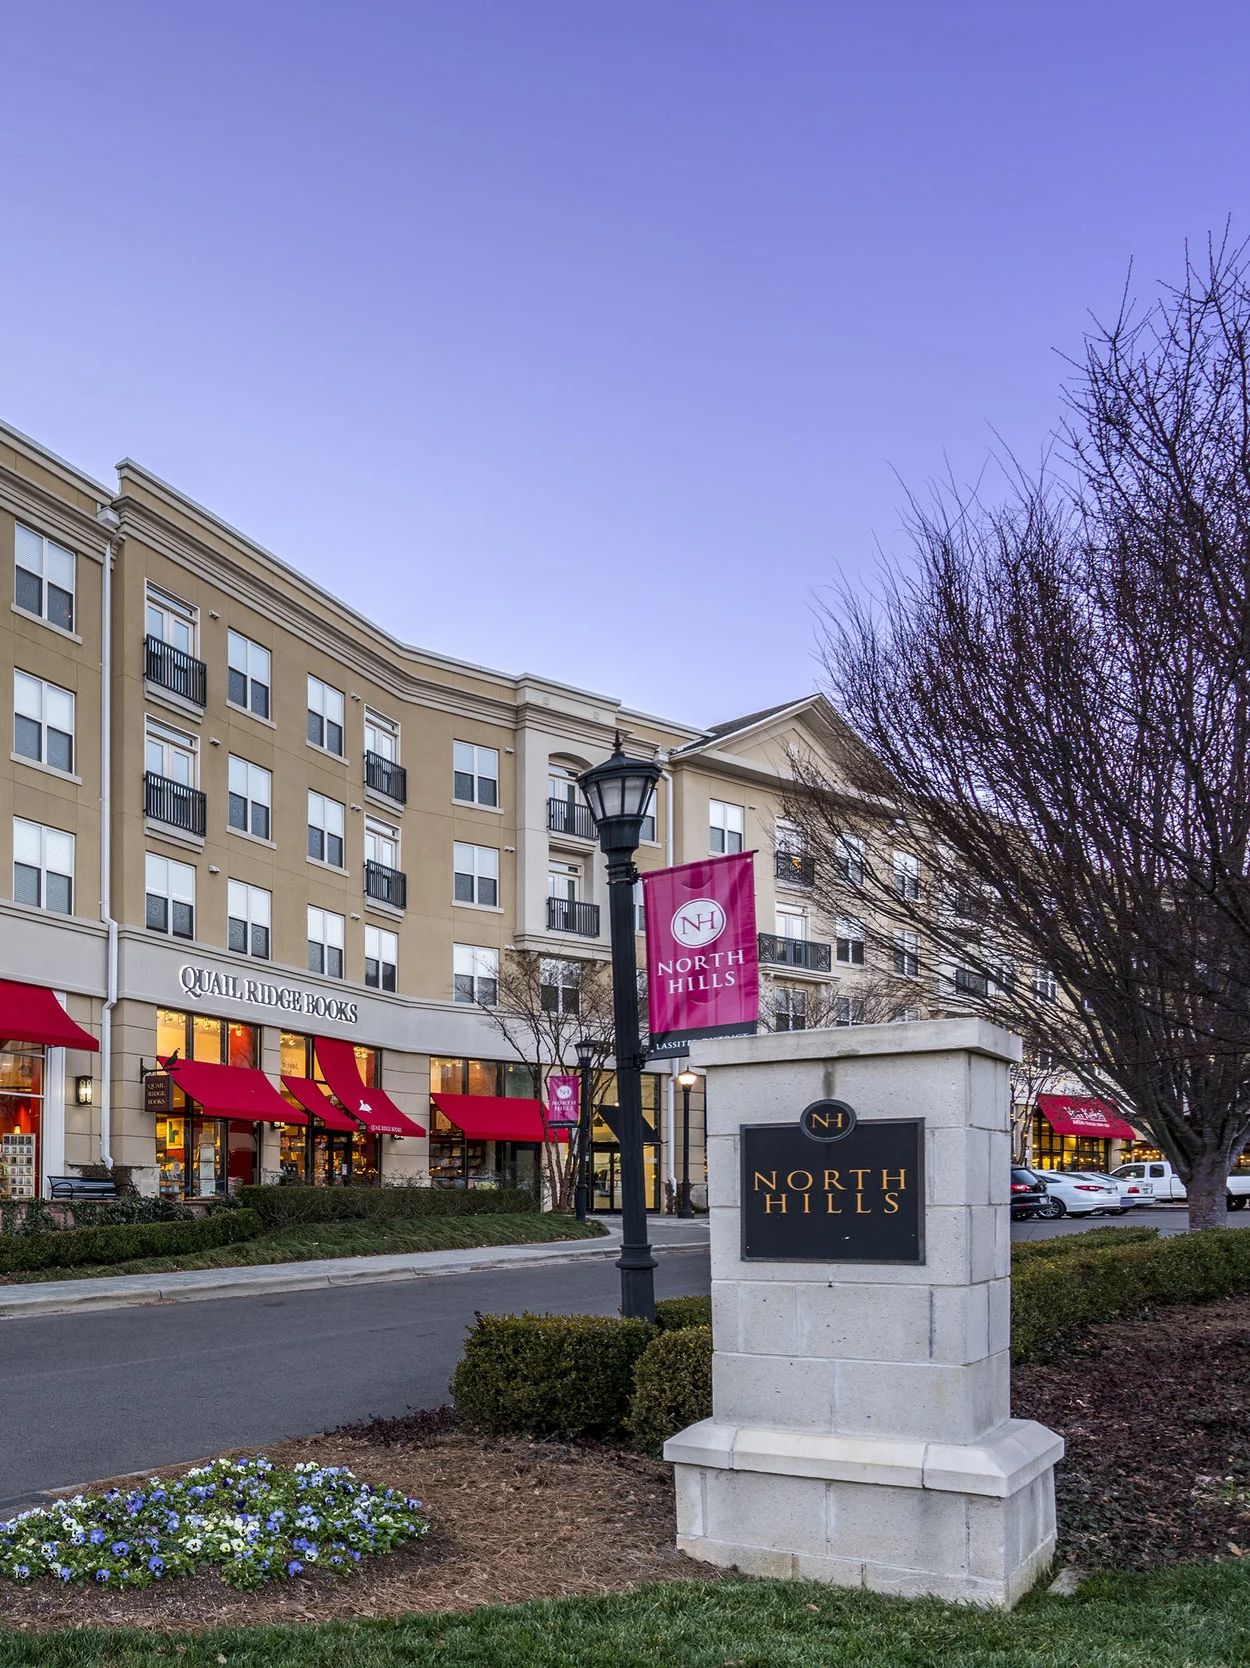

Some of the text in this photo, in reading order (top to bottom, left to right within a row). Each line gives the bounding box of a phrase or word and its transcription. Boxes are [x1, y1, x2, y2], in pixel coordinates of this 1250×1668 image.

[657, 950, 744, 977] NORTH
[181, 966, 358, 1023] QUAIL RIDGE BOOKS
[668, 971, 735, 995] HILLS
[811, 1113, 843, 1128] NH
[753, 1169, 907, 1191] NORTH
[764, 1192, 899, 1214] HILLS
